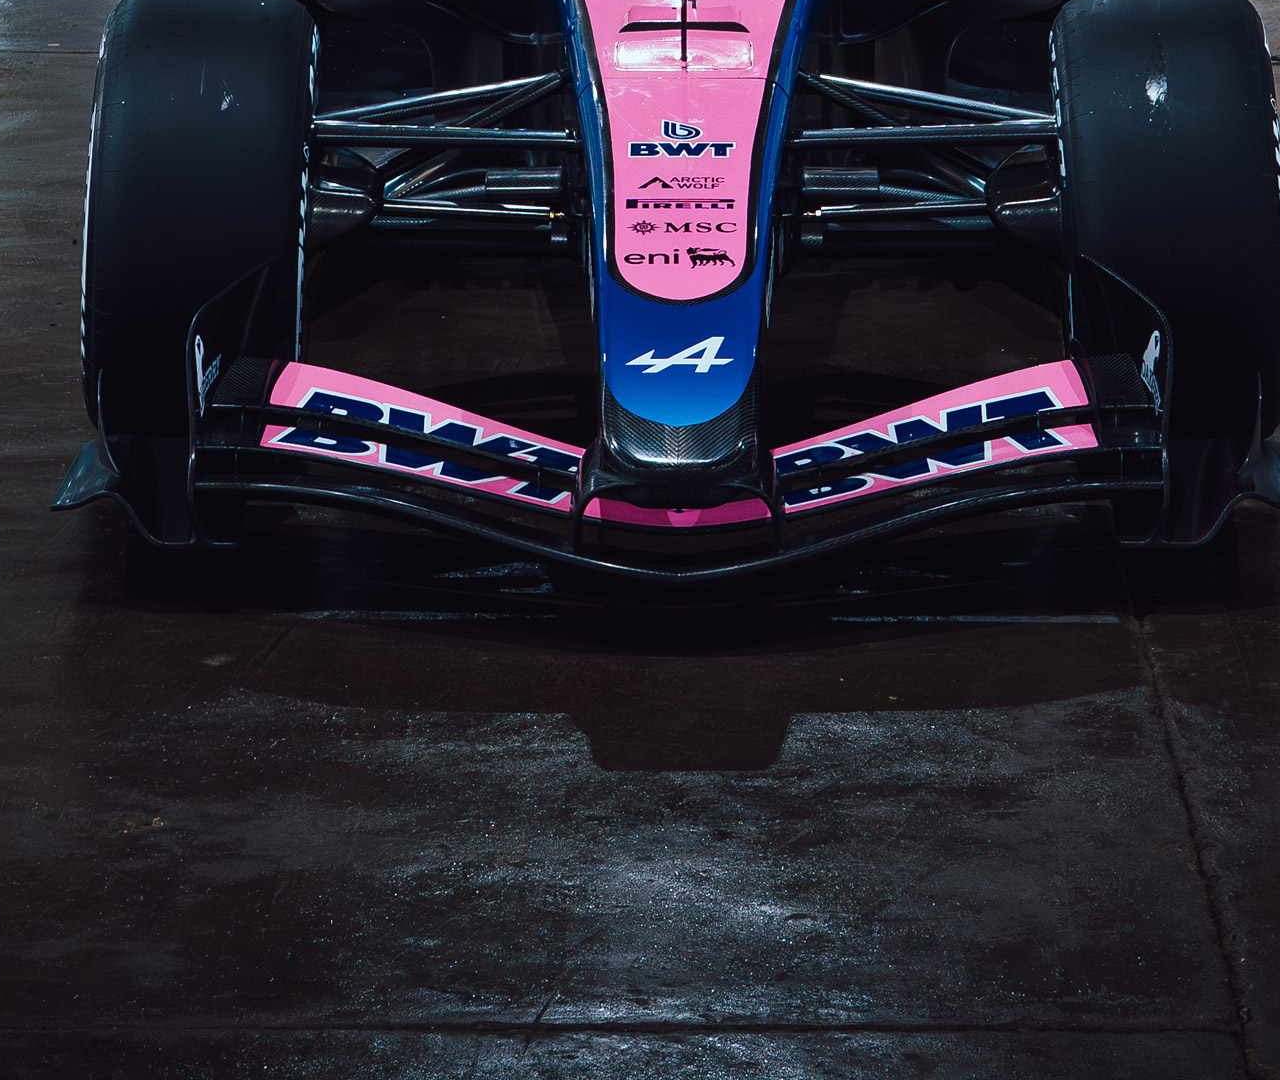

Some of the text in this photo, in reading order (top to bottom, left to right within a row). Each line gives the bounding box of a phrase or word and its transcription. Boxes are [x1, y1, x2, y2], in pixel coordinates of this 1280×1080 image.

[628, 142, 736, 158] BWT
[626, 198, 736, 209] PIRELLI
[663, 222, 738, 233] MSC
[623, 248, 680, 265] eni
[268, 386, 583, 505] BWT
[773, 386, 1074, 509] BWT
